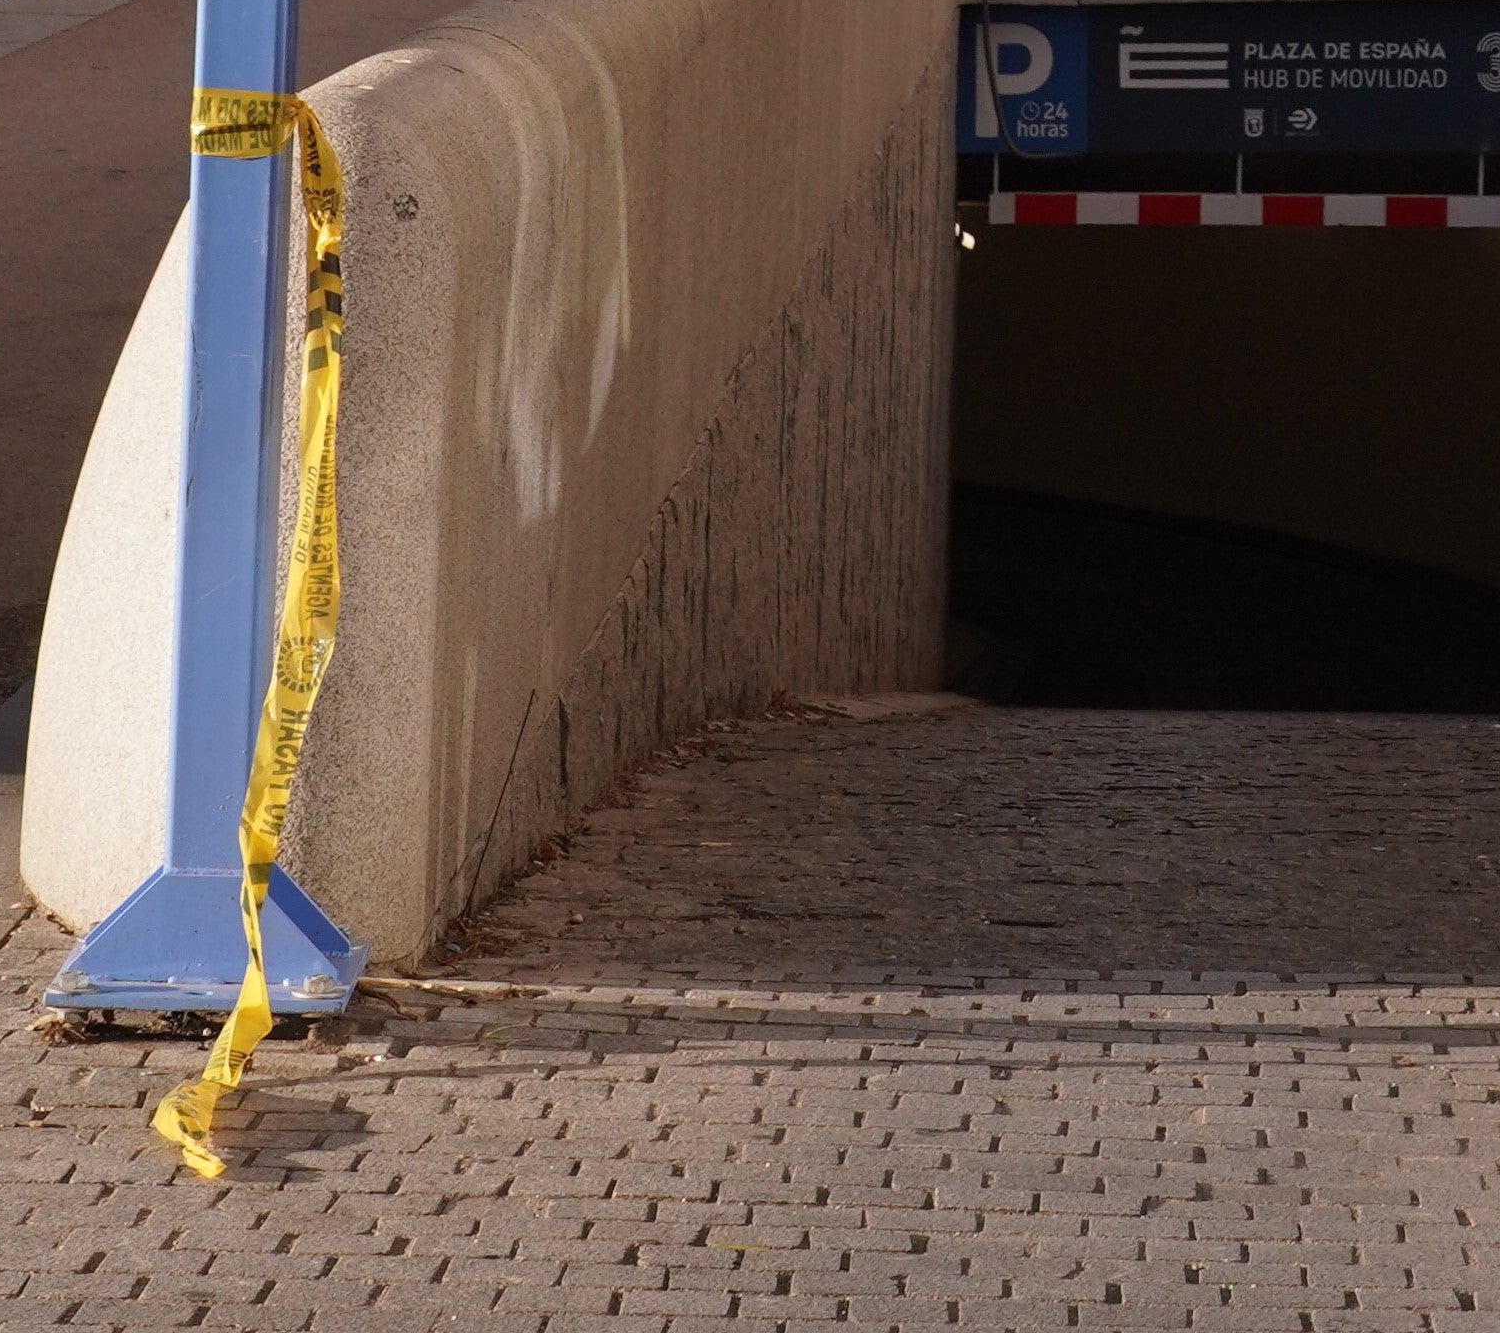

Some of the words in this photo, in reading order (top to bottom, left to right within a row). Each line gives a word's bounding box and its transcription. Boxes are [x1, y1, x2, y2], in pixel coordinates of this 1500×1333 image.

[1243, 42, 1316, 61] PLAZA
[1324, 43, 1351, 61] DE
[1359, 38, 1447, 61] ESPAÑA
[976, 22, 1053, 138] P
[1243, 68, 1289, 89] HUB
[1296, 69, 1324, 89] DE
[1330, 69, 1448, 90] MOVILIDAD
[1043, 100, 1069, 121] 24
[1016, 120, 1069, 138] horas
